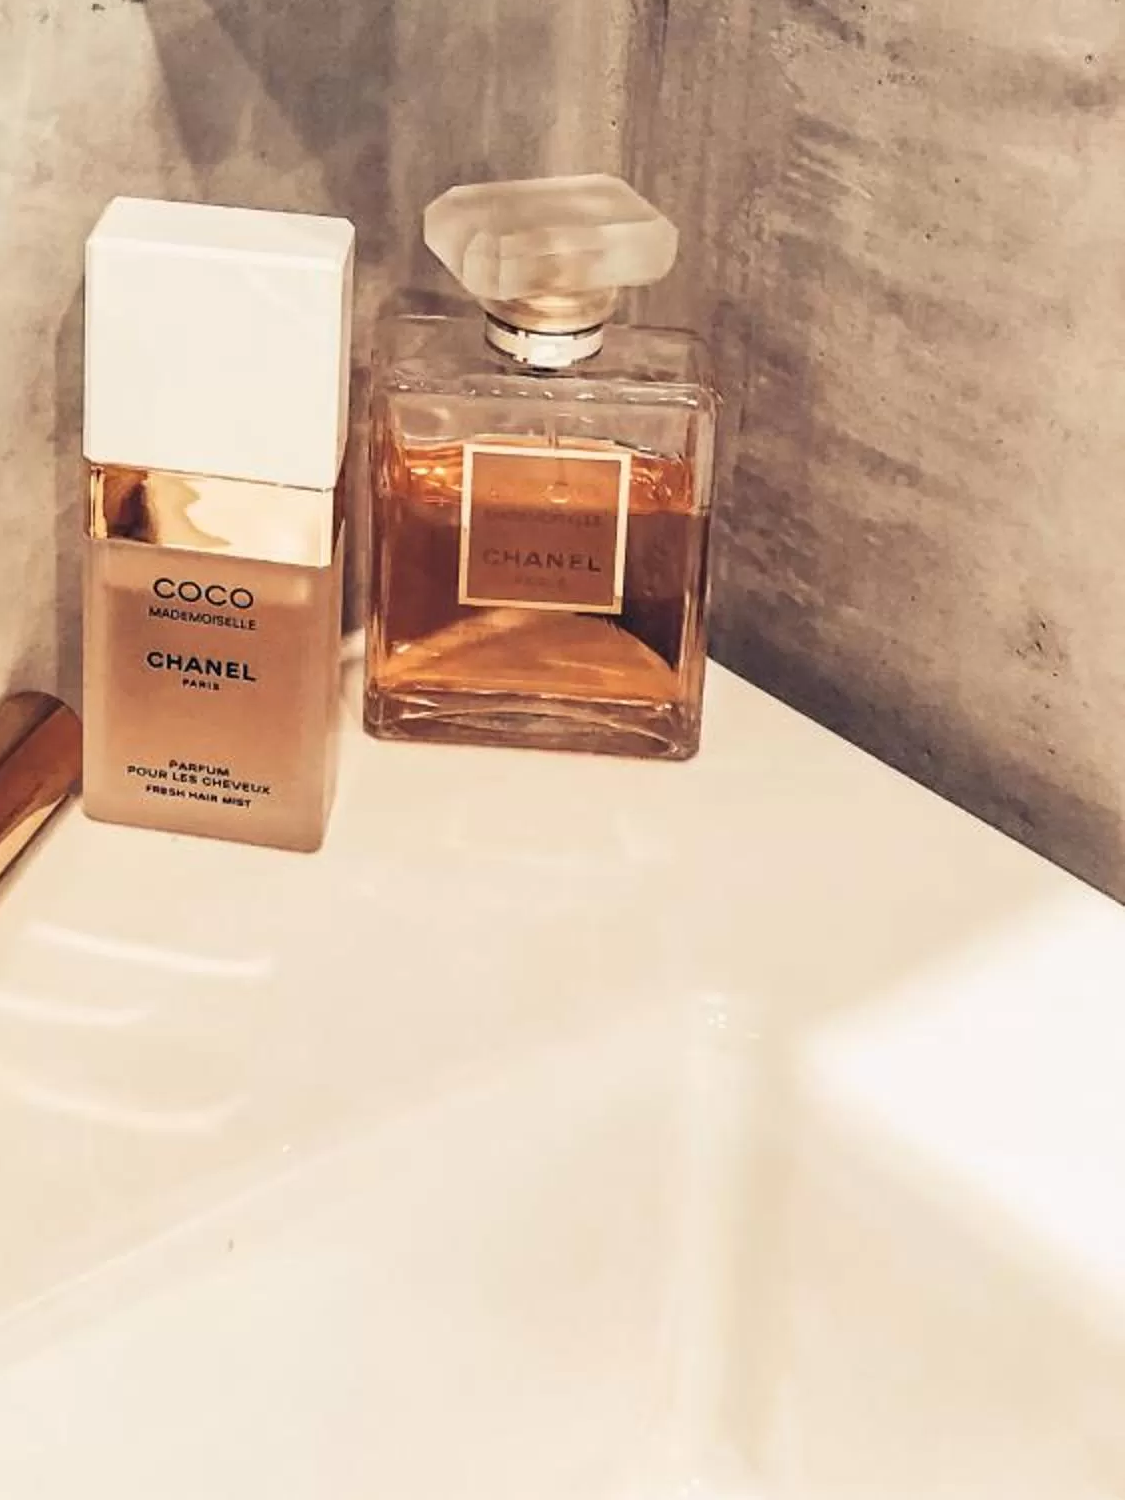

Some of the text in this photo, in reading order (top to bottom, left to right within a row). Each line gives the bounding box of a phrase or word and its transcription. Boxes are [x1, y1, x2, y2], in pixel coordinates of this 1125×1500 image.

[482, 549, 602, 573] CHANEL
[153, 577, 254, 609] COCO
[149, 606, 256, 631] MADEMOISELLE
[146, 651, 257, 681] CHANEL
[182, 678, 220, 691] PARIS
[127, 765, 271, 795] POUR LES CHEVEUX
[169, 759, 230, 777] PARFUM
[145, 784, 252, 809] FRESH HAIR MIST
